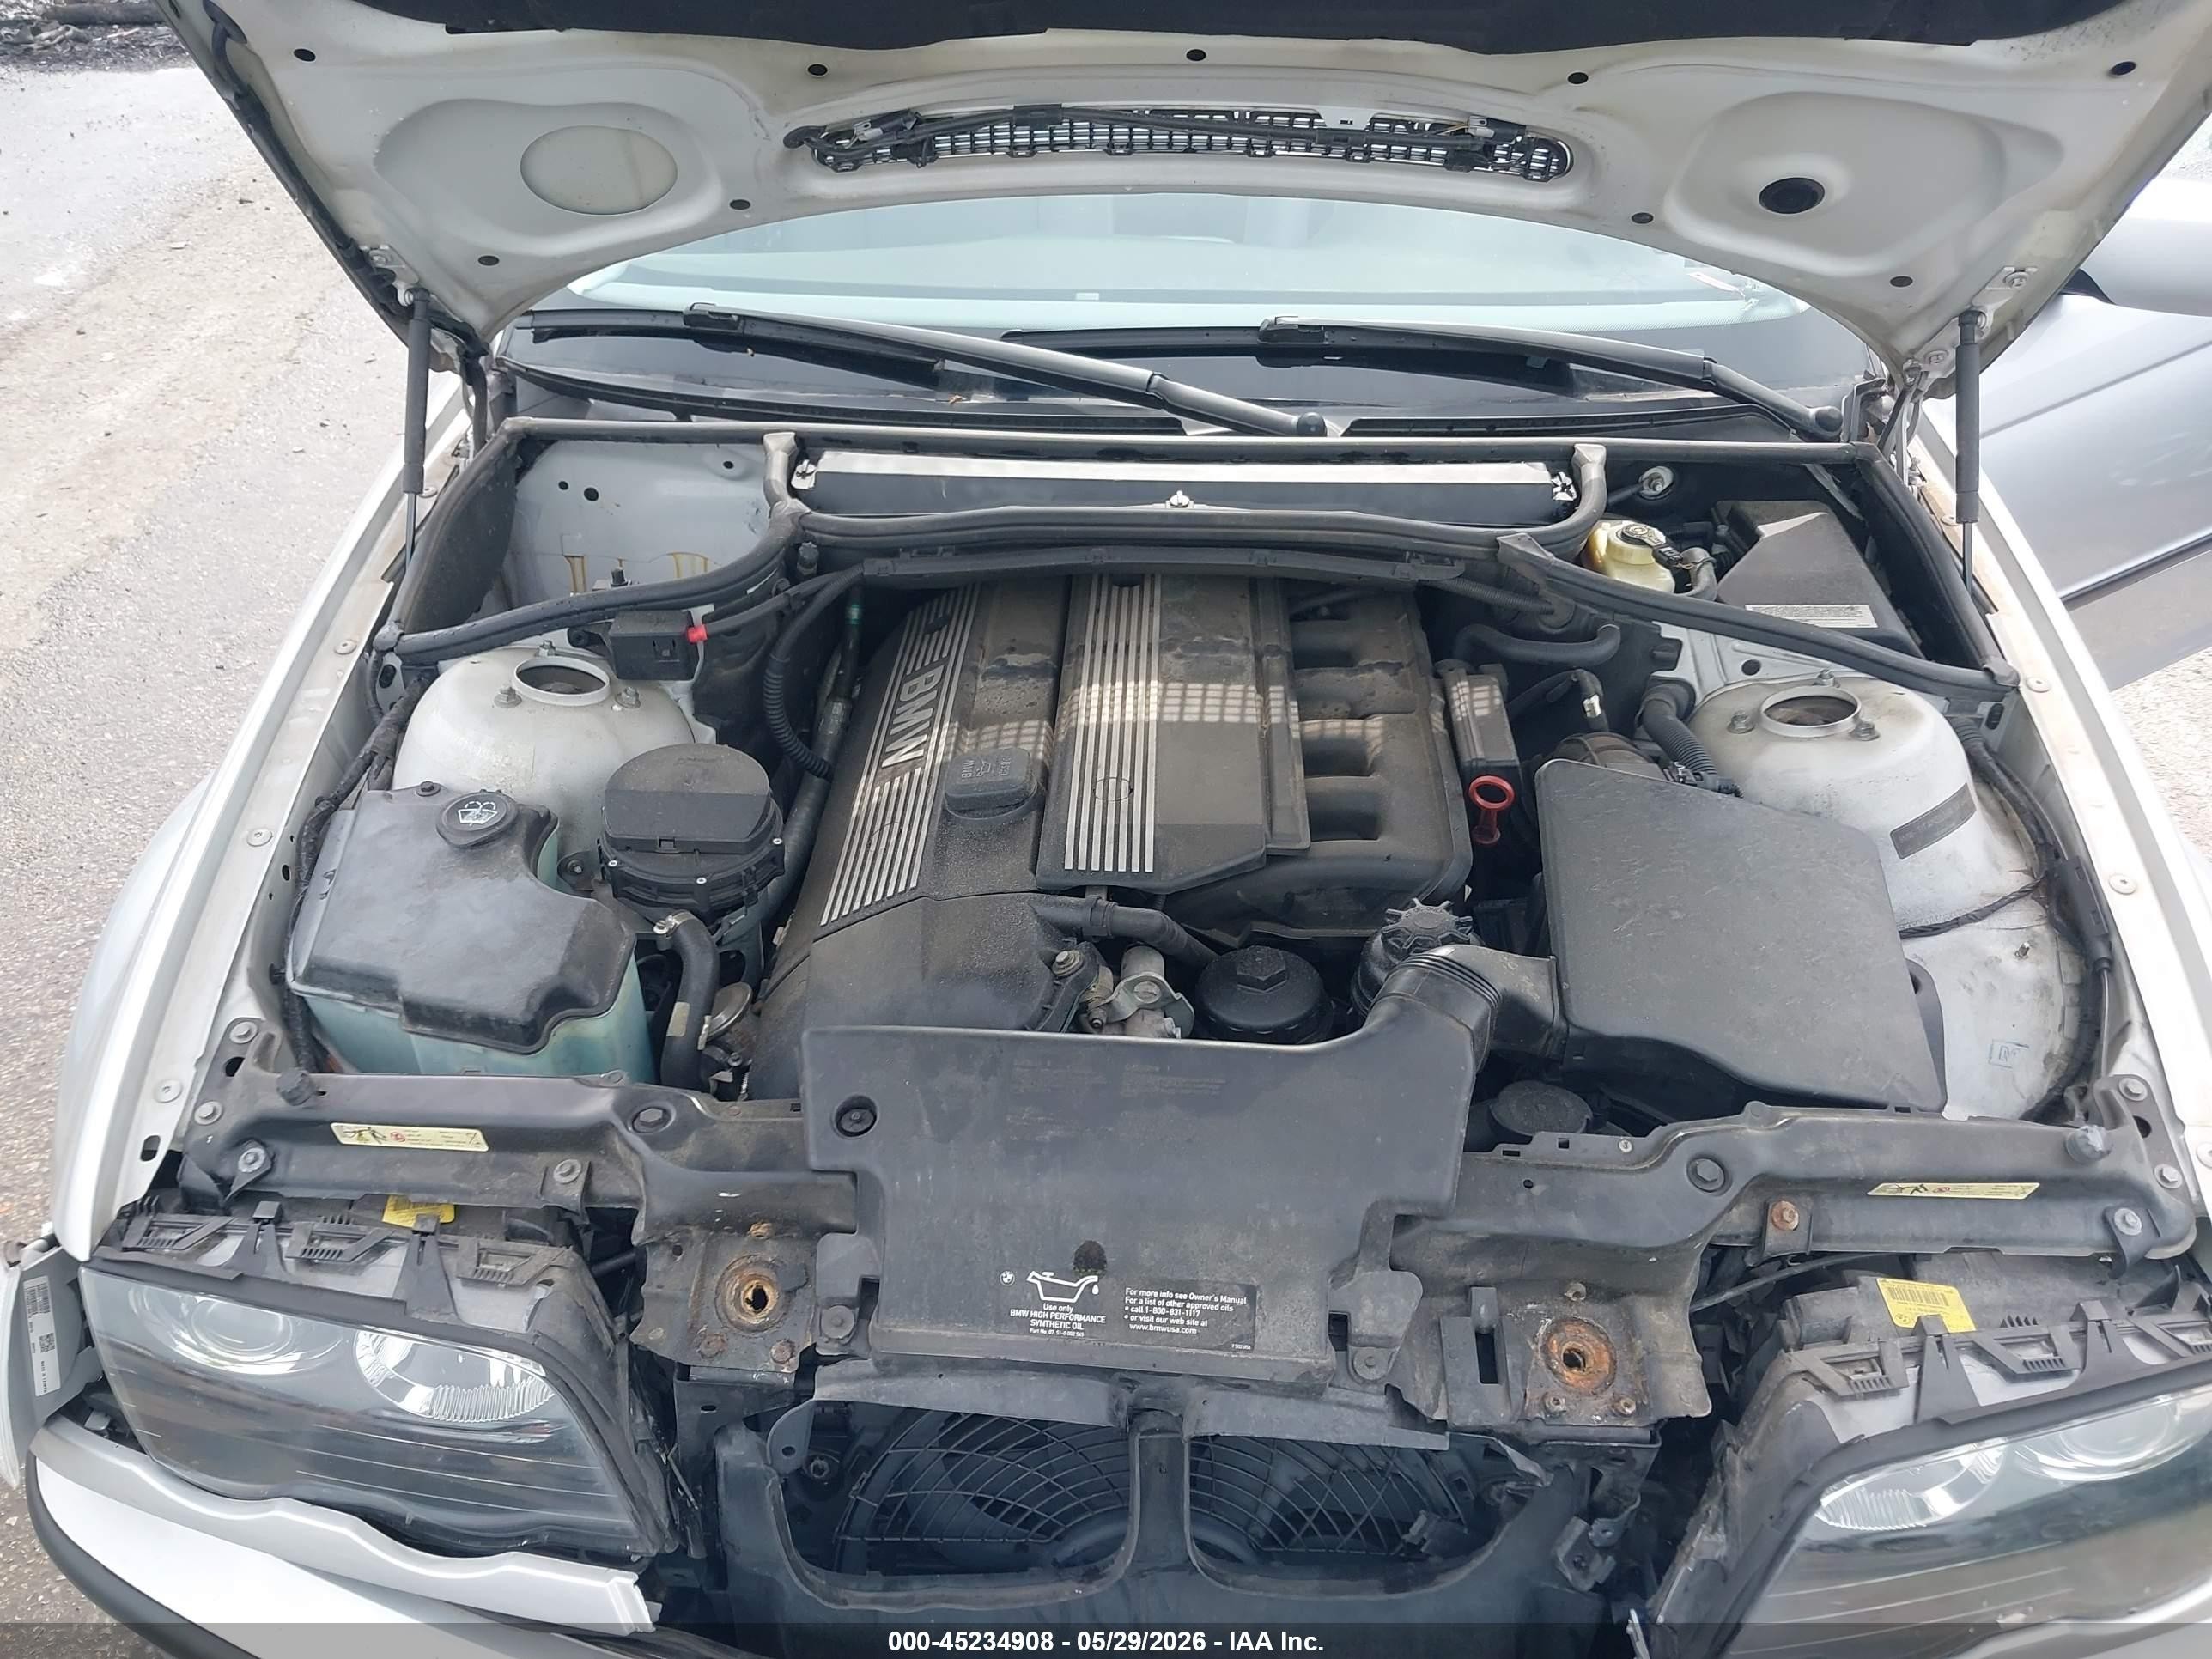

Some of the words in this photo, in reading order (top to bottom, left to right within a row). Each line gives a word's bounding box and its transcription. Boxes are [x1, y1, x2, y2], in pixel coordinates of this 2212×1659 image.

[882, 665, 945, 769] BMW
[961, 759, 975, 778] BMW
[1189, 1292, 1218, 1302] Owner's
[1220, 1295, 1247, 1304] Manual
[1043, 1303, 1057, 1311] Use
[1059, 1305, 1073, 1314] only
[1146, 1306, 1200, 1317] 1-800-831-1117
[1186, 1302, 1219, 1310] approved
[1010, 1309, 1030, 1317] BMW
[1030, 1310, 1048, 1319] HIGH
[1050, 1312, 1106, 1323] PERFORMANCE
[1139, 1314, 1154, 1322] visit
[1030, 1319, 1071, 1328] SYNTHETIC
[1072, 1322, 1084, 1330] OIL
[1129, 1323, 1197, 1334] www.bmwusa.com
